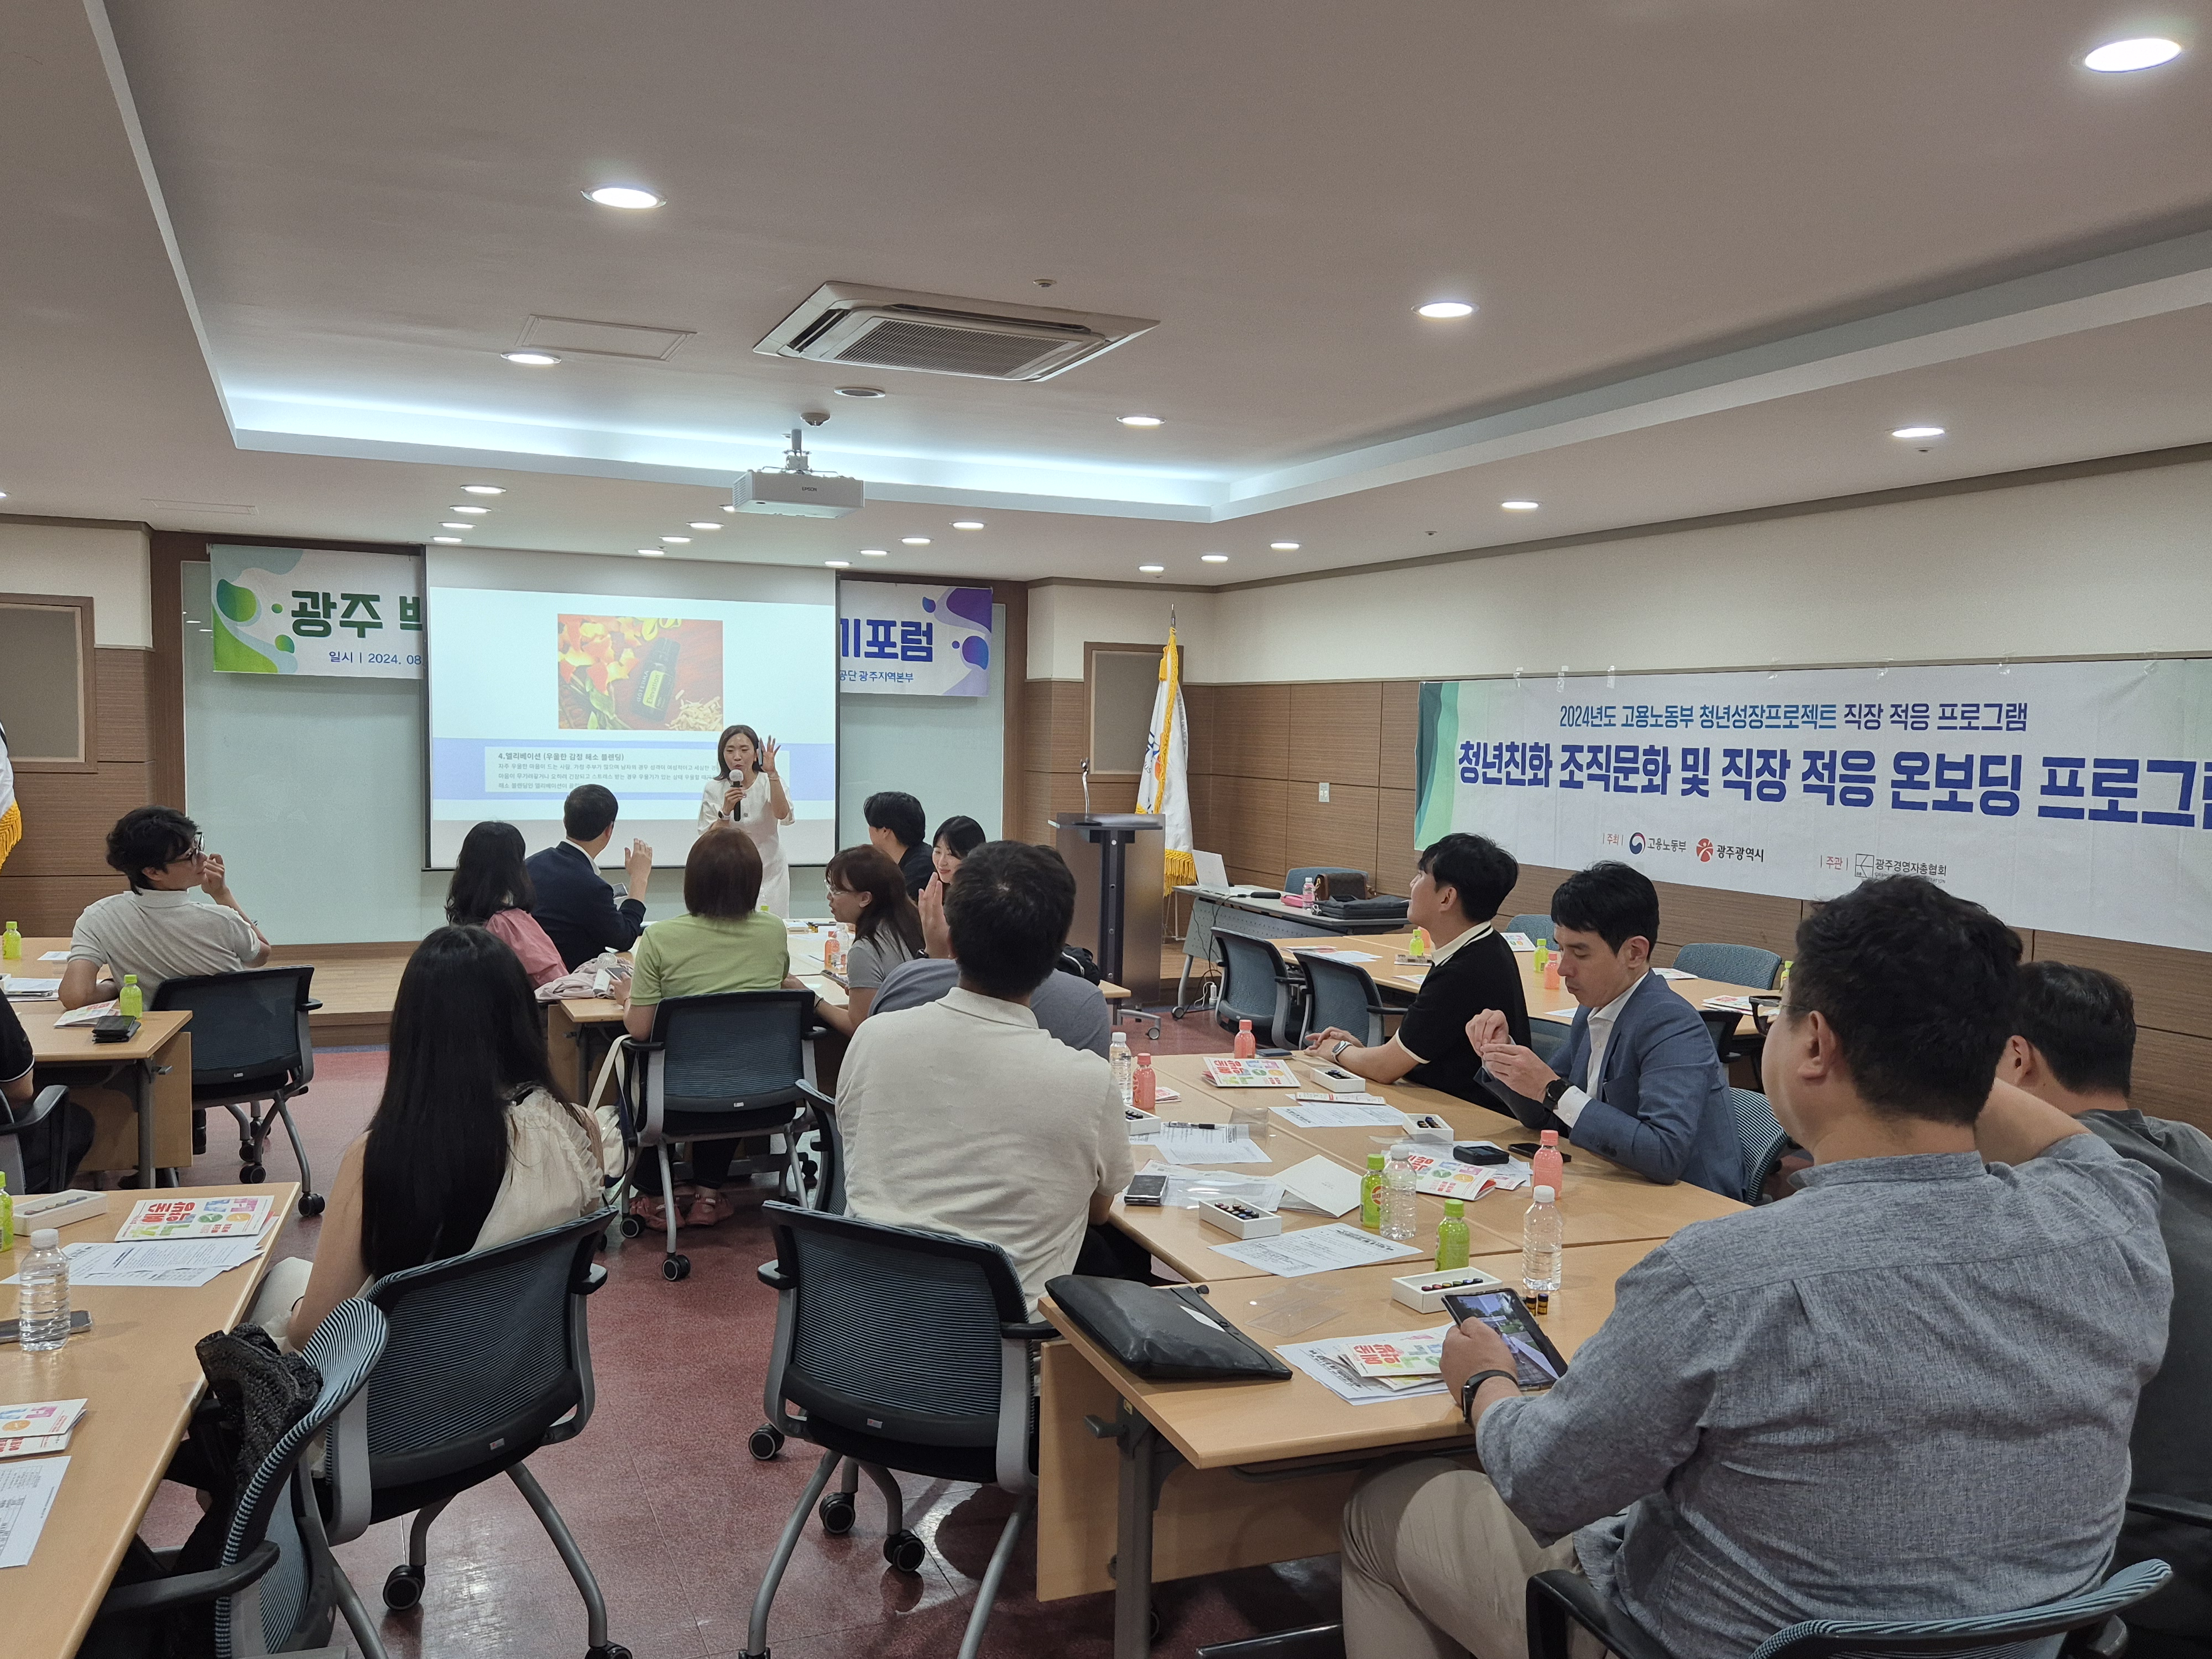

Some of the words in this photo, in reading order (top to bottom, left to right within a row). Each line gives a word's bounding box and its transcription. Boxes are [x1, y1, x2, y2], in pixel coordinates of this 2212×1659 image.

[291, 590, 383, 639] 광주
[328, 651, 353, 663] 일시
[368, 653, 401, 665] 2024.
[1559, 705, 1617, 728] 2024년도
[1620, 705, 1694, 729] 고용노동부
[1699, 703, 1837, 730] 청년성장프로젝트
[1843, 703, 1884, 731] 직장
[1889, 703, 1930, 731] 적응
[1937, 702, 2028, 732] 프로그램
[1458, 740, 1553, 789] 청년친화
[1558, 744, 1672, 796] 조직문화
[1679, 747, 1711, 799] 및
[1721, 747, 1791, 803] 직장
[1801, 749, 1876, 808] 적응
[1890, 750, 2023, 818] 온보딩
[1606, 833, 1620, 846] 주최
[1647, 837, 1687, 853] 고용노동부
[1716, 844, 1765, 863] 광주광역시
[1825, 855, 1843, 870] 주관
[1875, 859, 1947, 877] 광주경영자총협회
